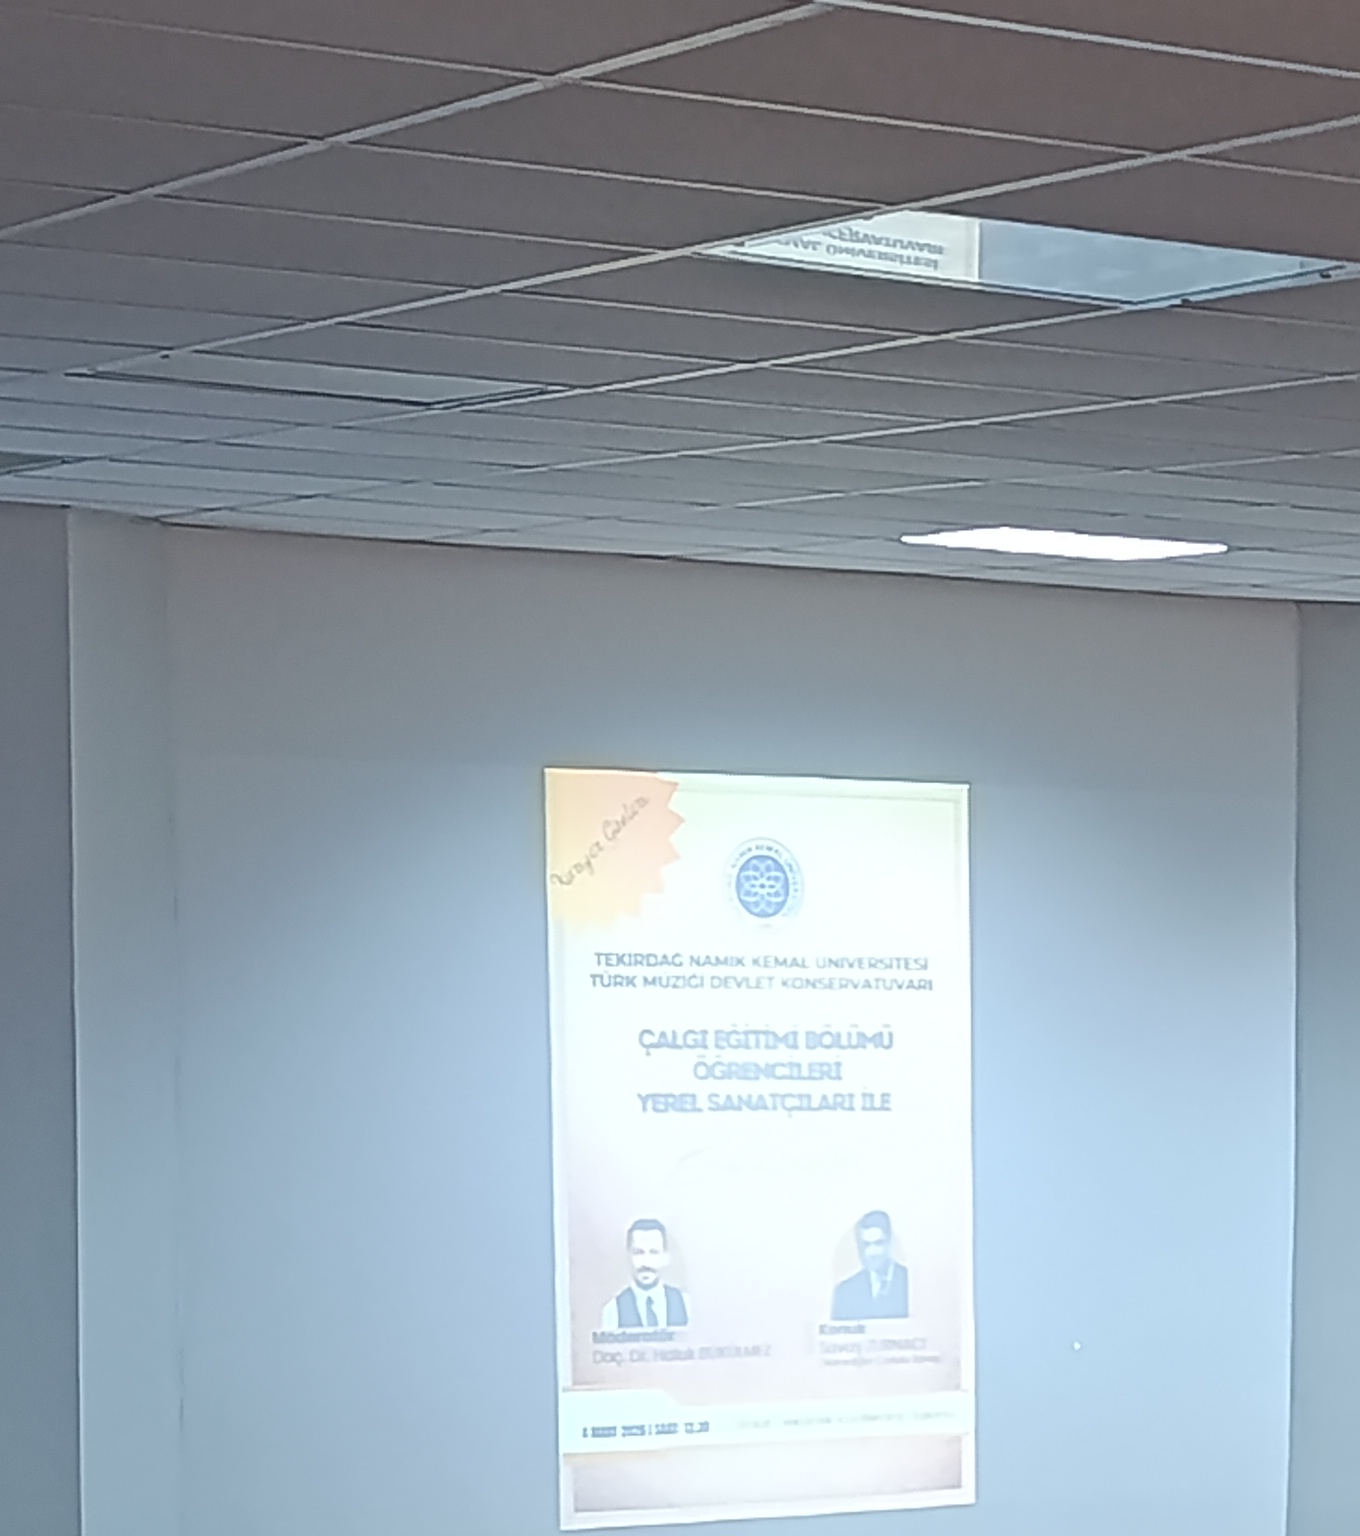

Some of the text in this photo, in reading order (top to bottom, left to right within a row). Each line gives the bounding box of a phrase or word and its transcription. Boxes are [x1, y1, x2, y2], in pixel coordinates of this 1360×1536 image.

[689, 954, 746, 968] NAMIK
[752, 954, 810, 969] KEMAL
[590, 969, 638, 988] TÜRK
[710, 974, 776, 990] DEVLET
[781, 976, 934, 991] KONSERVATUVARI
[638, 1028, 708, 1056] ÇALGI
[636, 1092, 704, 1113] YEREL
[707, 1092, 855, 1117] SANATÇILARI
